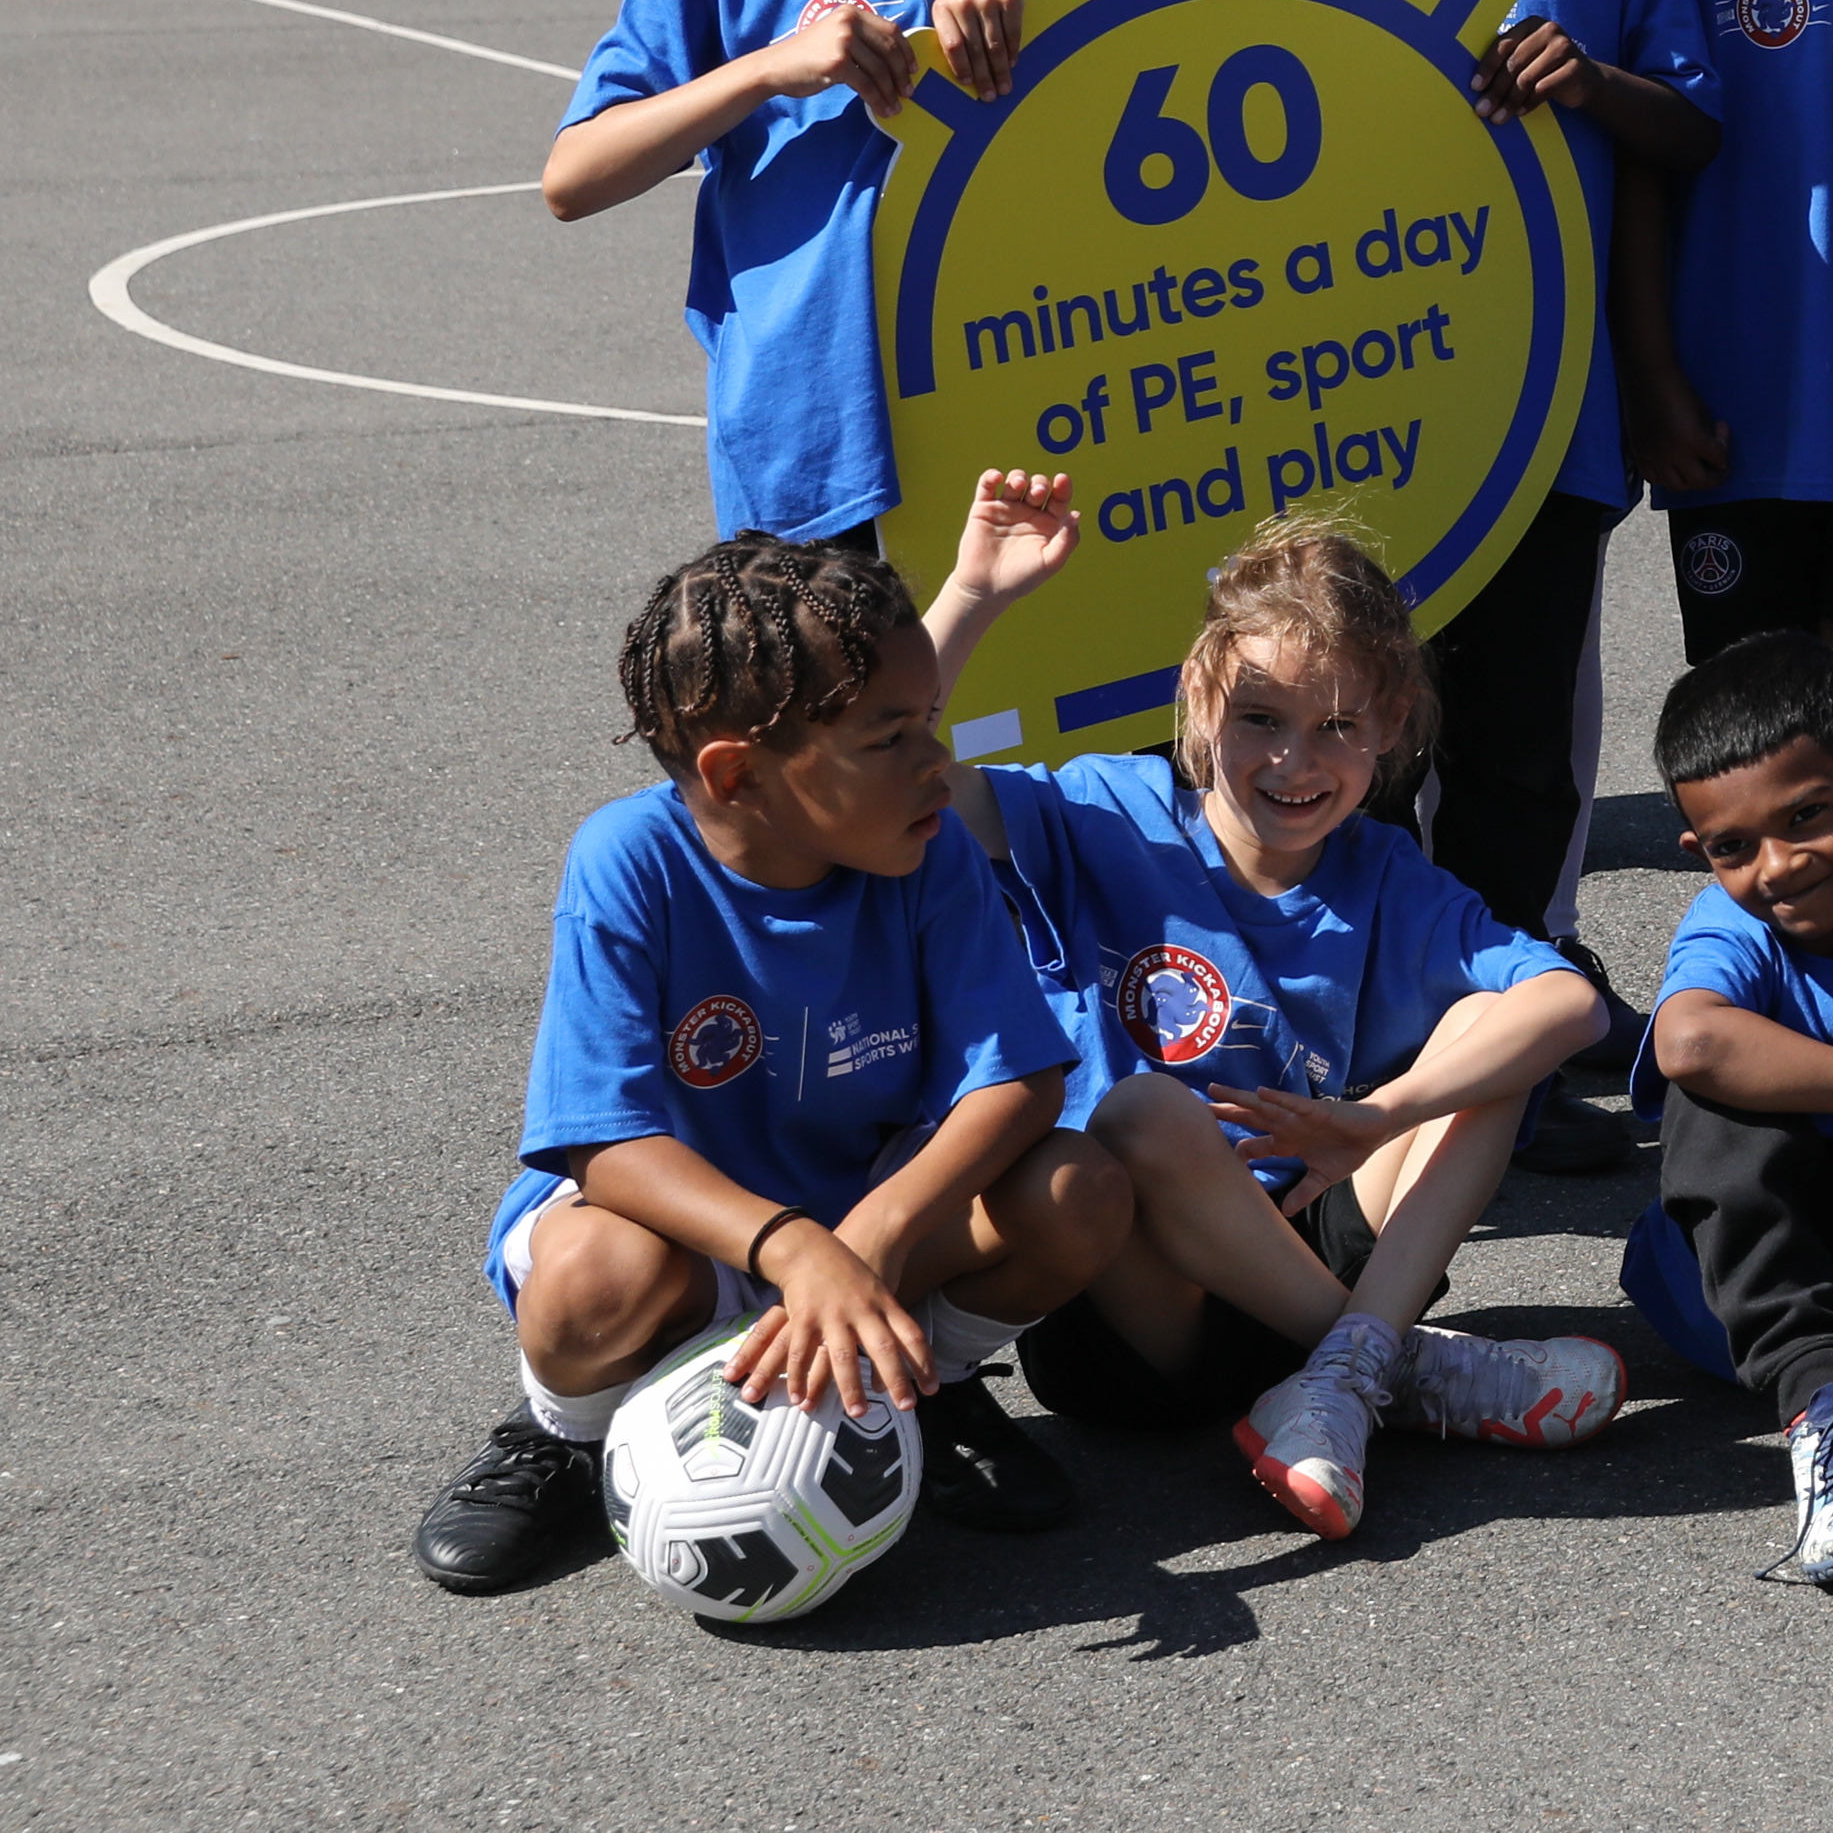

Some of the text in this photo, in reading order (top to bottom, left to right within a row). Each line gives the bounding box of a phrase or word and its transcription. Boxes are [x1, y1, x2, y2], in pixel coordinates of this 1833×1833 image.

[1104, 45, 1322, 226] 60
[963, 206, 1491, 370] minutes a day
[1036, 303, 1455, 454] of PE, sport
[1098, 419, 1423, 543] and play
[1688, 535, 1731, 552] PARIS
[1125, 952, 1224, 1049] MONSTER KICKABOUT
[675, 1002, 757, 1074] MONSTER KICKABOUT
[852, 1027, 910, 1056] NATIONAL
[854, 1044, 896, 1071] SPORTS
[1305, 1059, 1330, 1076] SPORT
[1309, 1050, 1331, 1067] YOUTH
